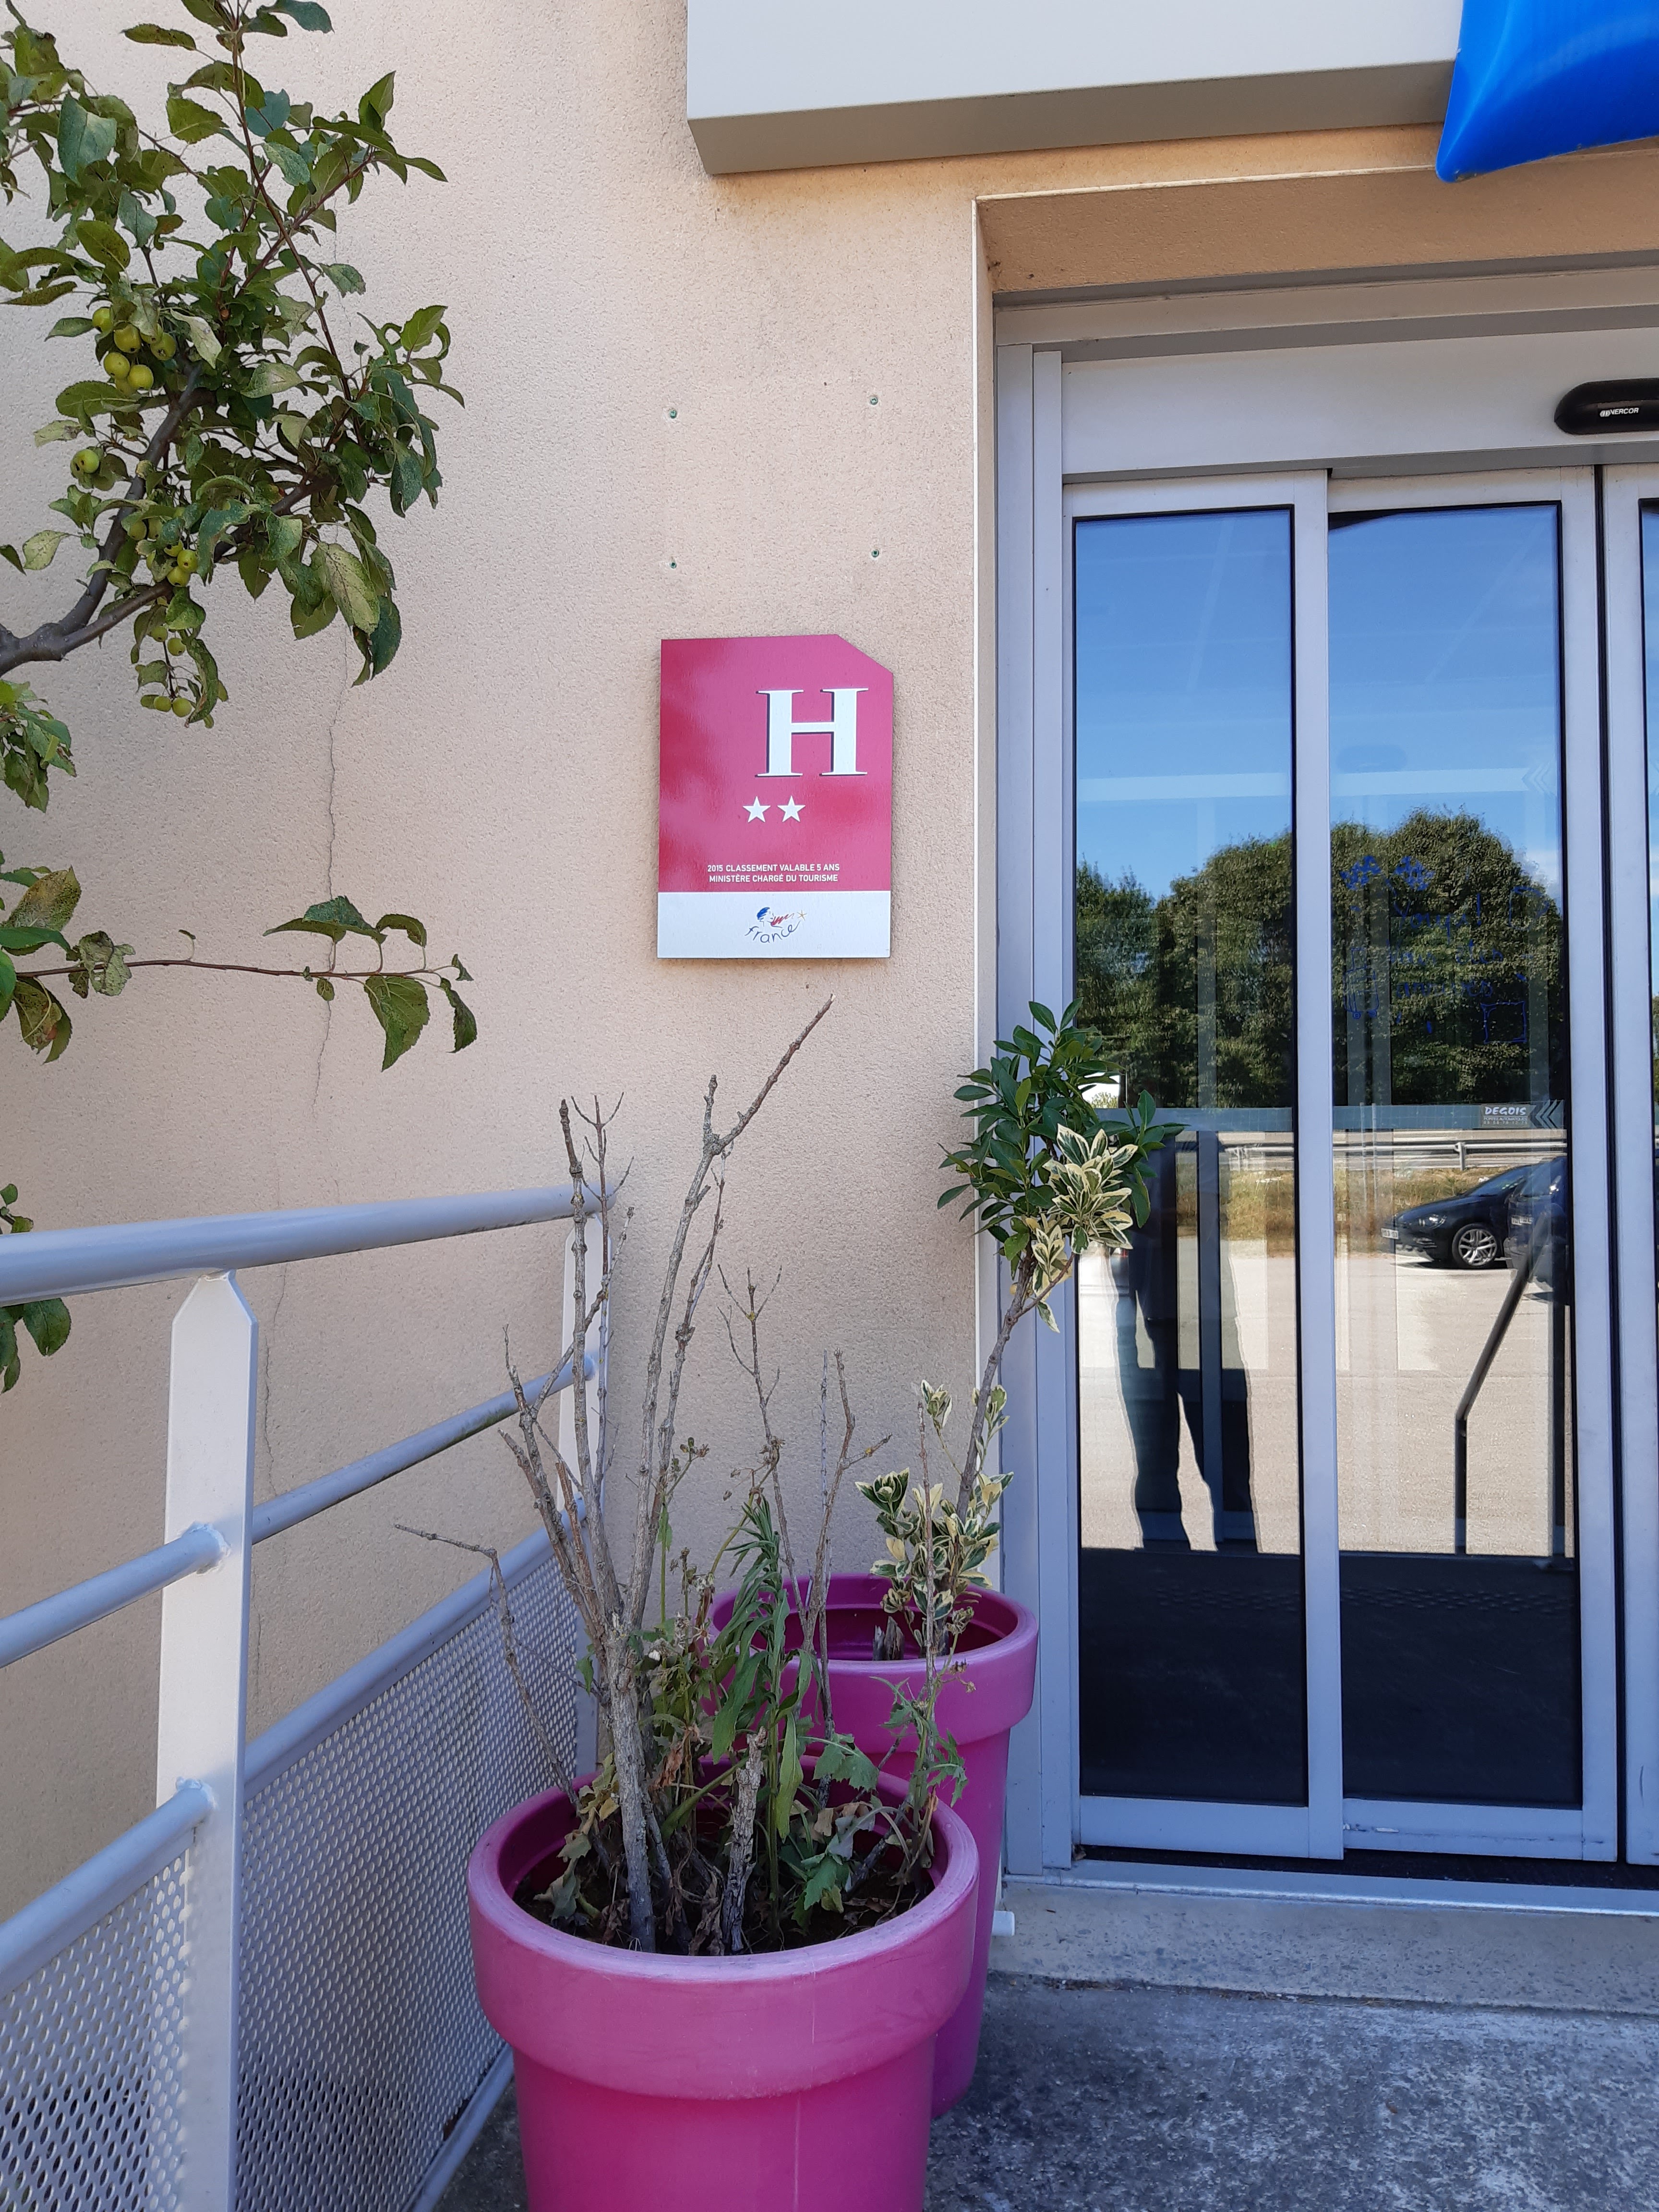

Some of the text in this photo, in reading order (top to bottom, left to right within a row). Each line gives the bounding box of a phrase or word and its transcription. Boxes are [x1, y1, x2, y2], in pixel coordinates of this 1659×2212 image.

[755, 688, 869, 777] H
[725, 864, 778, 872] CLASSEMENT
[709, 874, 751, 883] MINISTÈRE
[752, 873, 784, 882] CHARGÉ
[798, 874, 838, 882] TOURISME
[745, 920, 801, 943] france
[1485, 1106, 1527, 1115] DEGOIS
